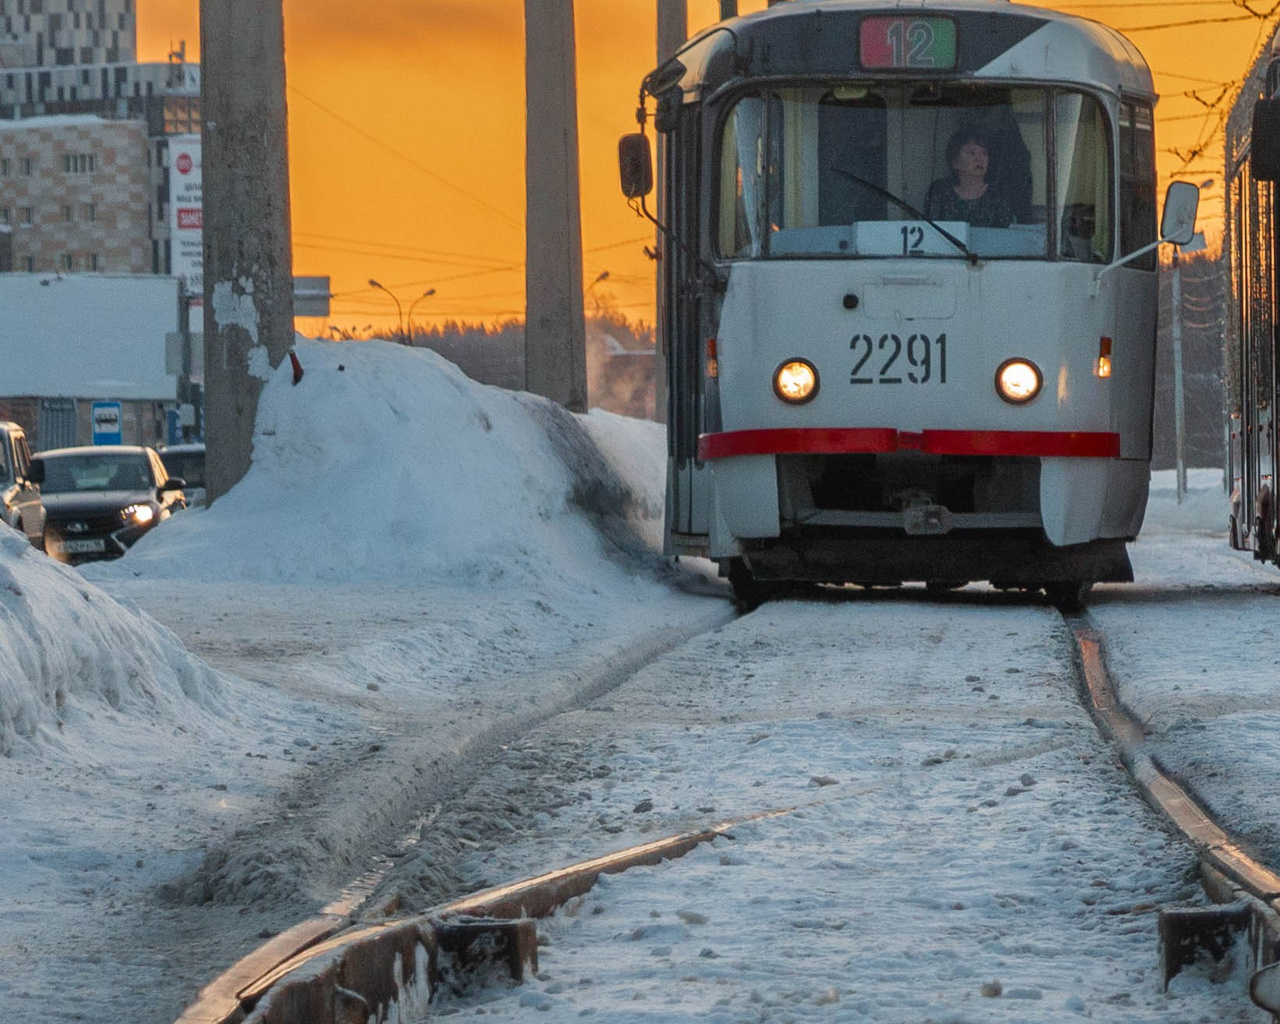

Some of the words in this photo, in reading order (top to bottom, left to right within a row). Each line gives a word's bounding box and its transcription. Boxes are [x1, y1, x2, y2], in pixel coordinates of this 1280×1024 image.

[887, 20, 935, 68] 12
[901, 226, 924, 256] 12
[850, 333, 947, 384] 2291
